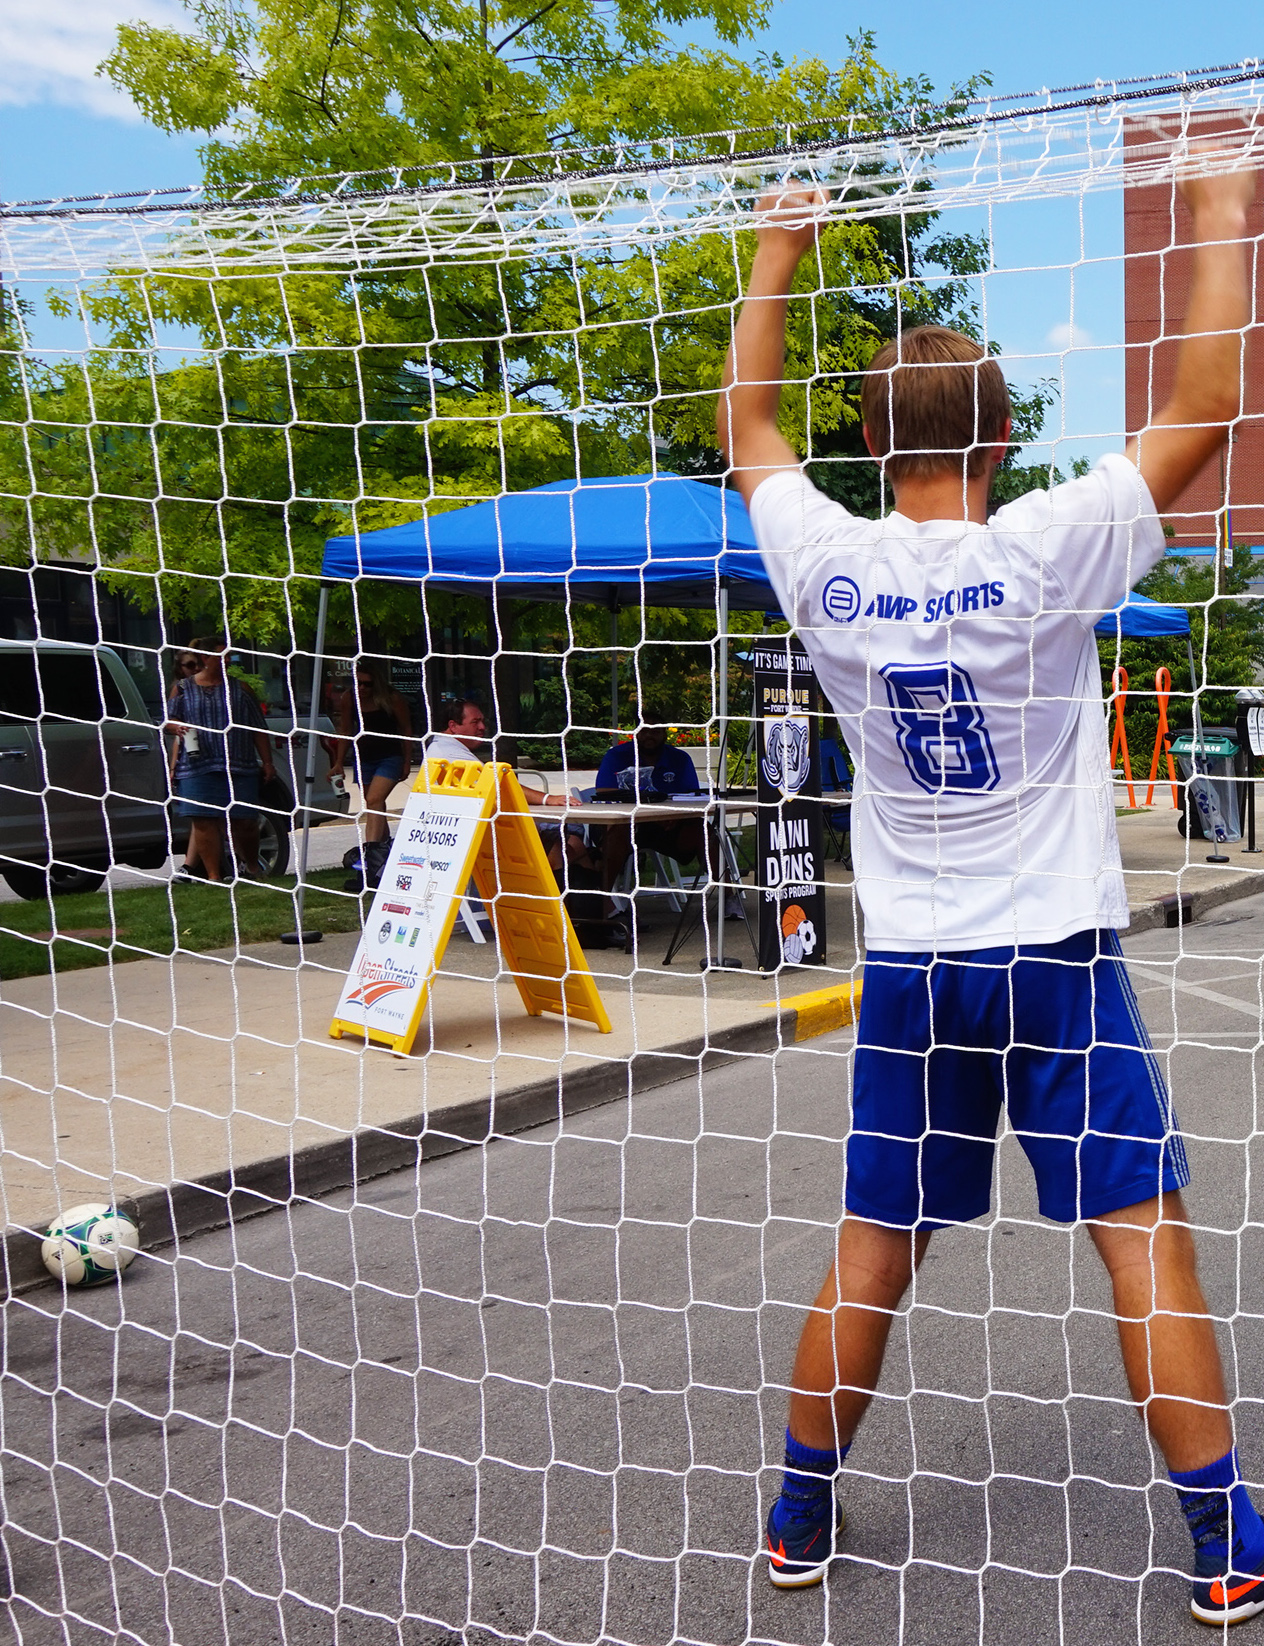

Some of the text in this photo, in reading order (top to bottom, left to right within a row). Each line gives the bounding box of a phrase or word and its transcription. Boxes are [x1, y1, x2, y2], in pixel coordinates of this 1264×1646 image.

[864, 580, 1005, 624] AWP SPORTS
[335, 660, 361, 671] 110
[755, 652, 772, 669] IT'S
[772, 653, 795, 670] GAME
[763, 687, 809, 705] PURDUE
[771, 704, 785, 713] FORT
[878, 660, 1003, 797] 8
[408, 828, 458, 847] SPONSORS
[769, 818, 810, 851] MINI
[766, 851, 815, 886] DONS
[788, 884, 817, 899] PROGRAM
